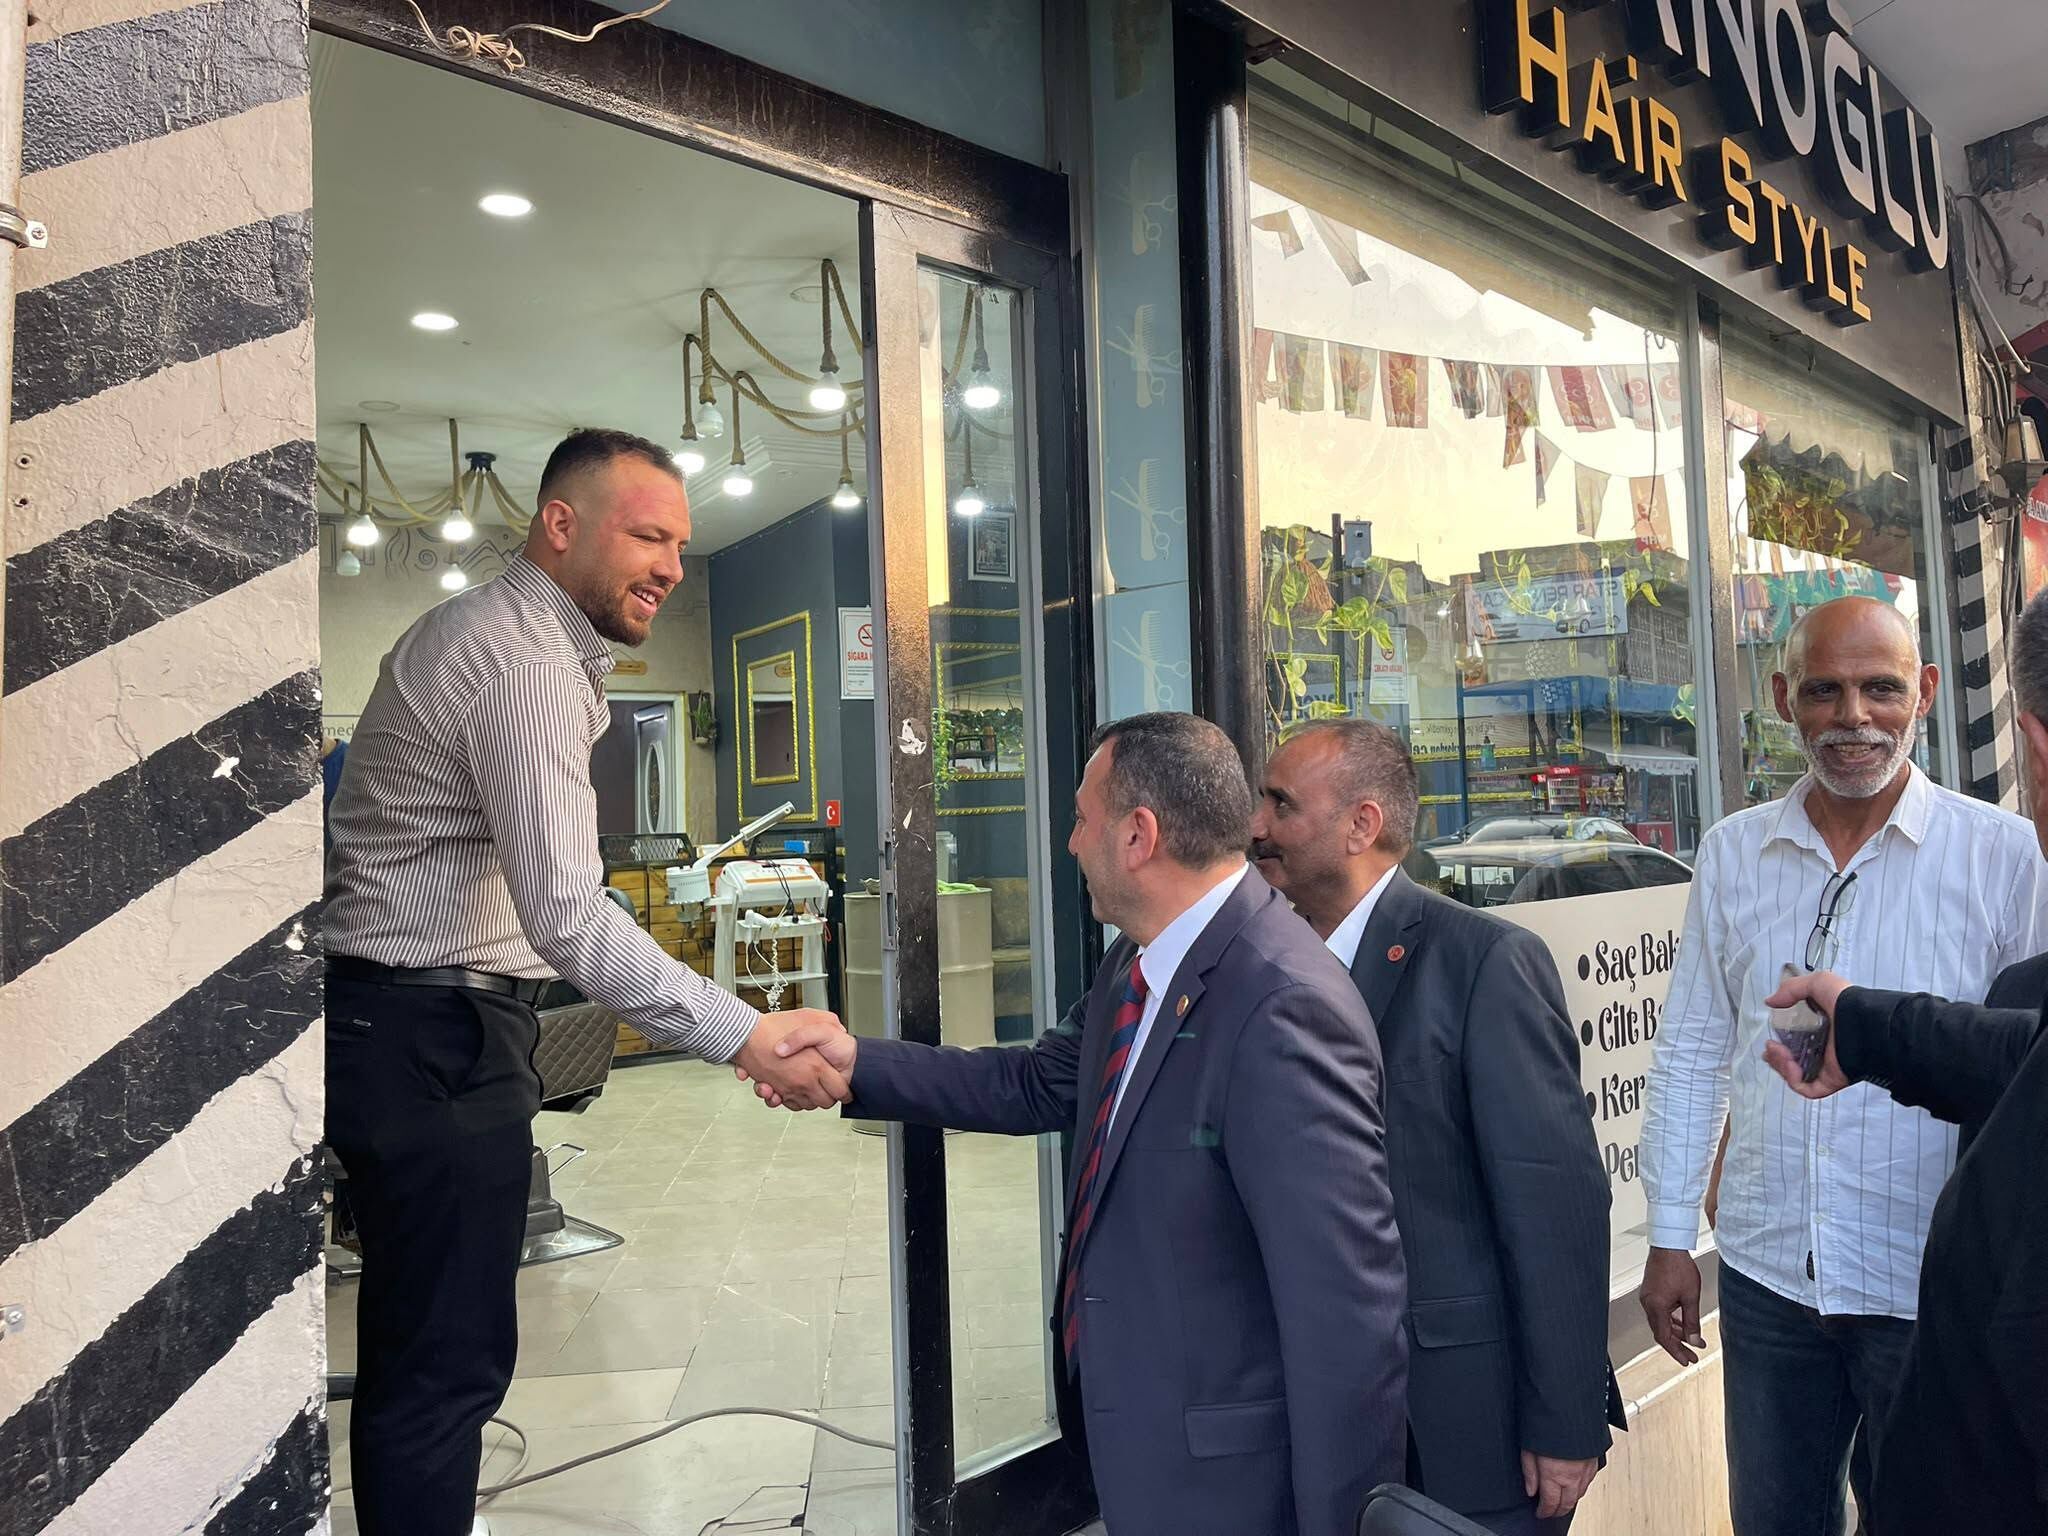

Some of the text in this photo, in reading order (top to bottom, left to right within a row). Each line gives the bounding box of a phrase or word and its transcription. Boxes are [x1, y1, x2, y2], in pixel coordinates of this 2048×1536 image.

[1720, 136, 1871, 321] STYLE
[1595, 940, 1637, 992] Saç
[1599, 997, 1663, 1052] Cilt B
